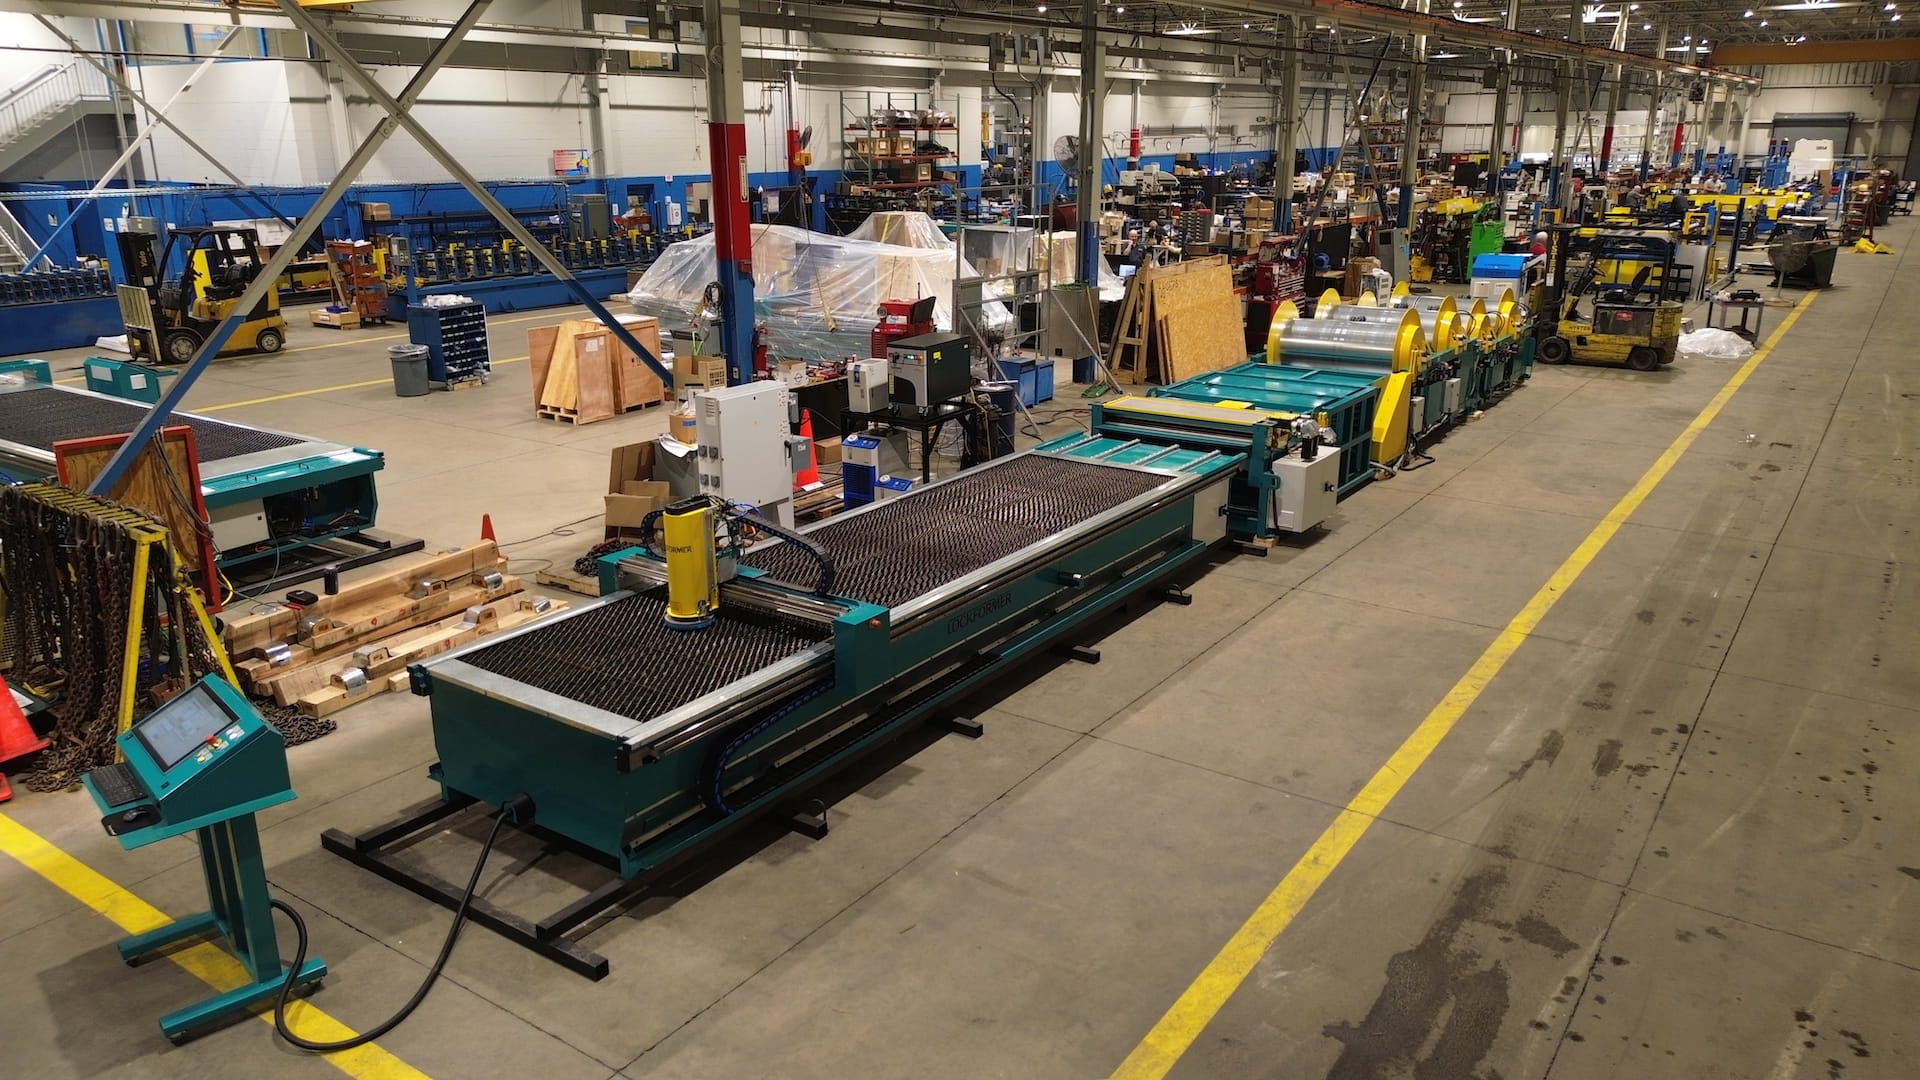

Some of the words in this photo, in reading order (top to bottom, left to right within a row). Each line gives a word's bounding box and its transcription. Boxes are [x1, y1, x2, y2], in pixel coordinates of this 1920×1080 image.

[139, 250, 148, 267] Yale
[1549, 231, 1560, 273] HYSTER
[947, 592, 1012, 634] LOCKFORMER
